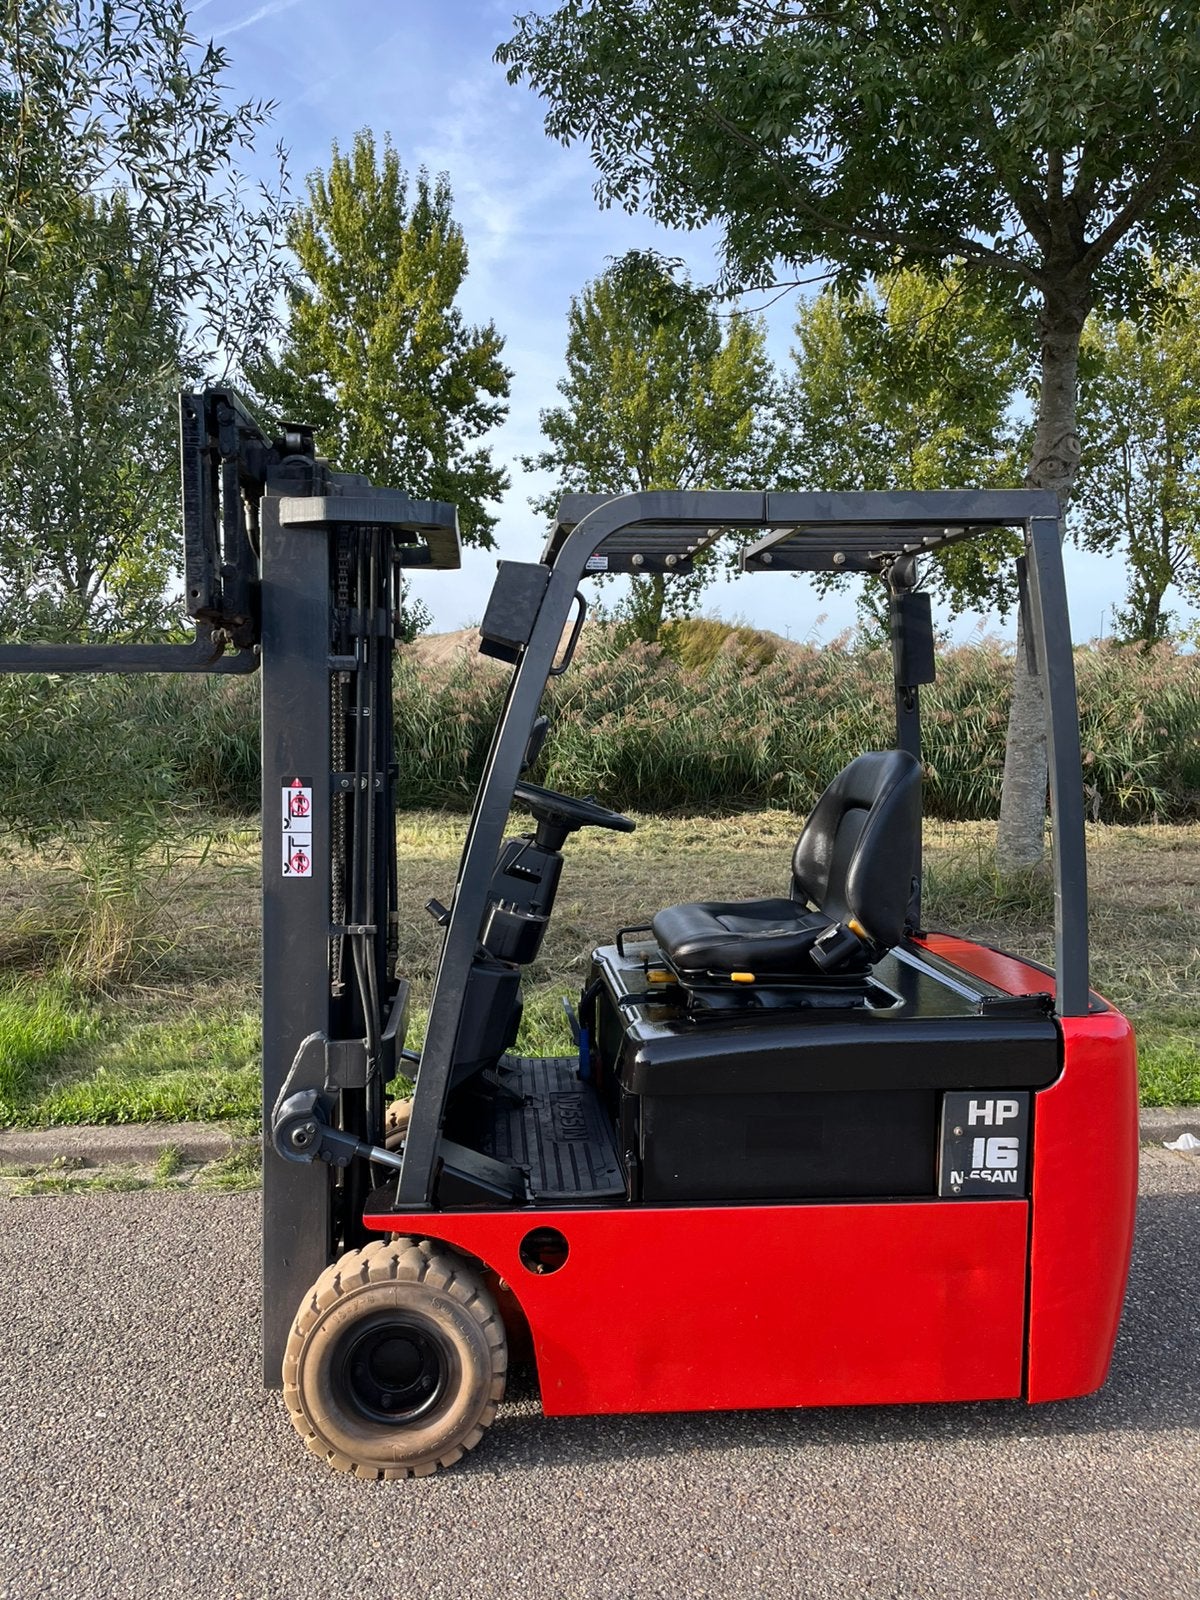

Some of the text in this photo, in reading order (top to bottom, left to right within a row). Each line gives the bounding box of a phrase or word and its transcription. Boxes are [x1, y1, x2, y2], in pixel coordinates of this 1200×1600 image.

[557, 1094, 590, 1141] NISSAN
[968, 1100, 1019, 1125] HP
[972, 1137, 1019, 1168] 16
[950, 1170, 1018, 1184] NSSAN
